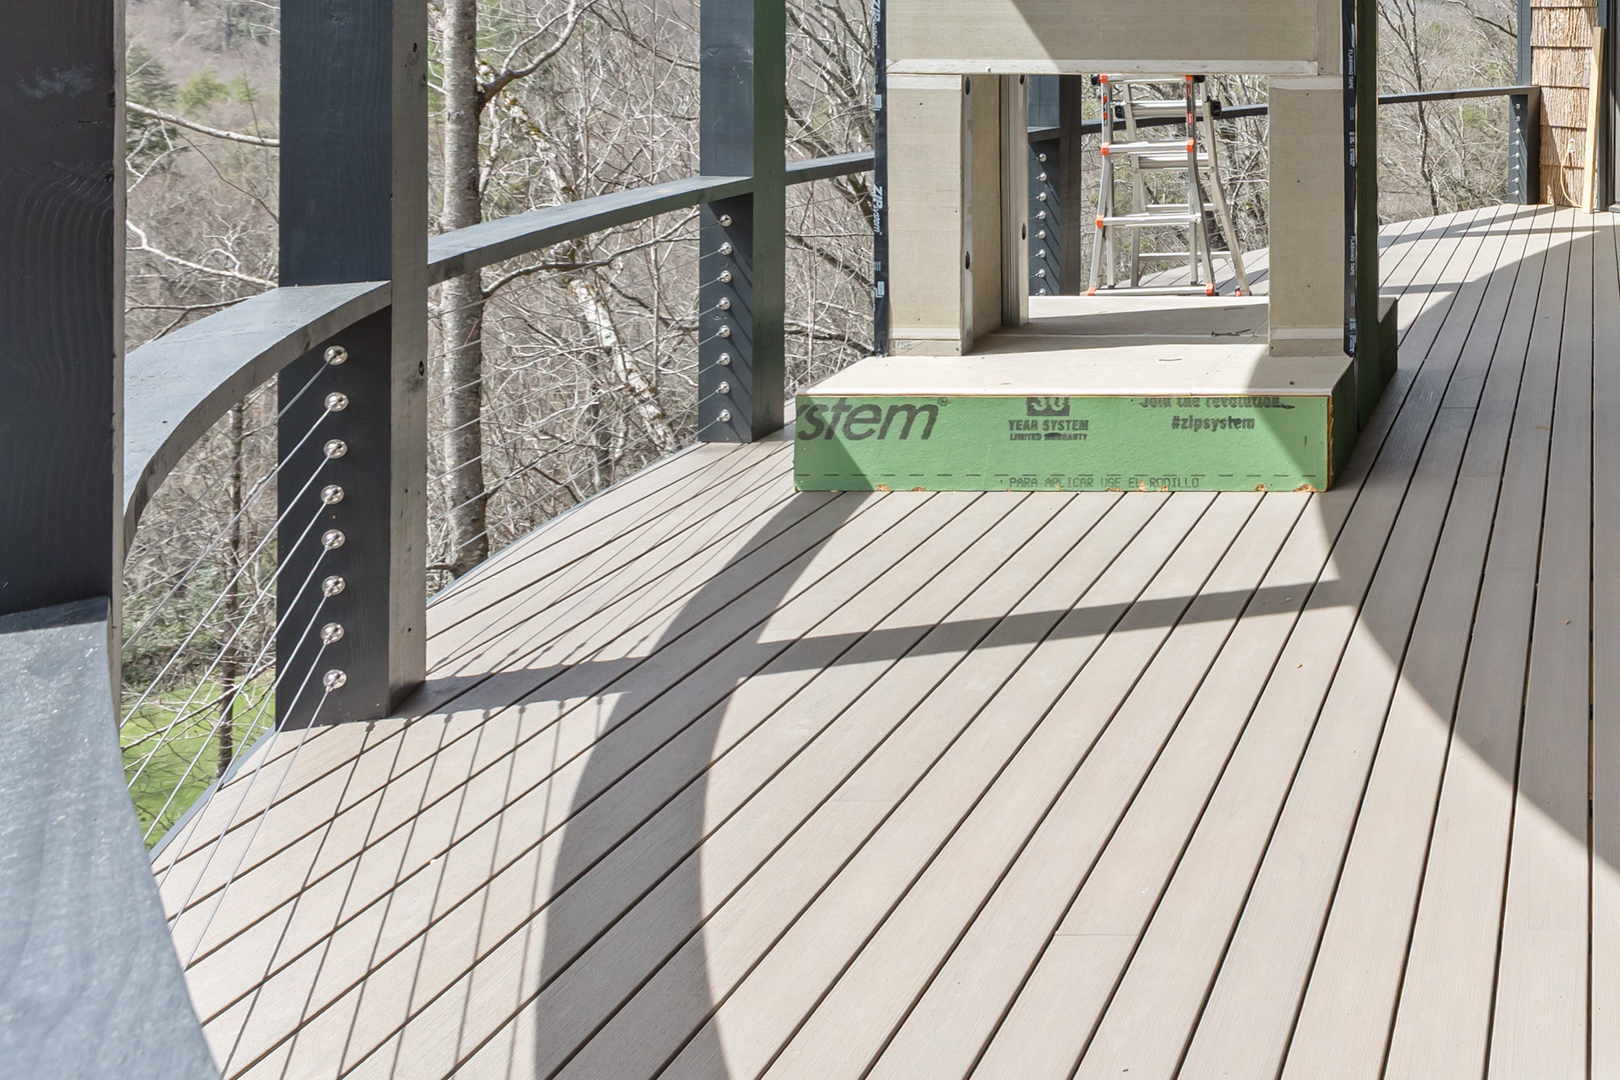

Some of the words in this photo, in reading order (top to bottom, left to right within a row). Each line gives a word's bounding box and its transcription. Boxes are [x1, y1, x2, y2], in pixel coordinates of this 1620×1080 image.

[796, 398, 939, 440] stem
[1009, 419, 1038, 431] YEAR
[1043, 419, 1089, 431] SYSTEM
[1171, 415, 1255, 432] #zipsystem
[1010, 433, 1042, 441] LIMITED
[1009, 477, 1038, 488] PARA
[1044, 477, 1094, 488] APLICAR
[1100, 477, 1121, 488] USE
[1149, 477, 1200, 488] RODILLO
